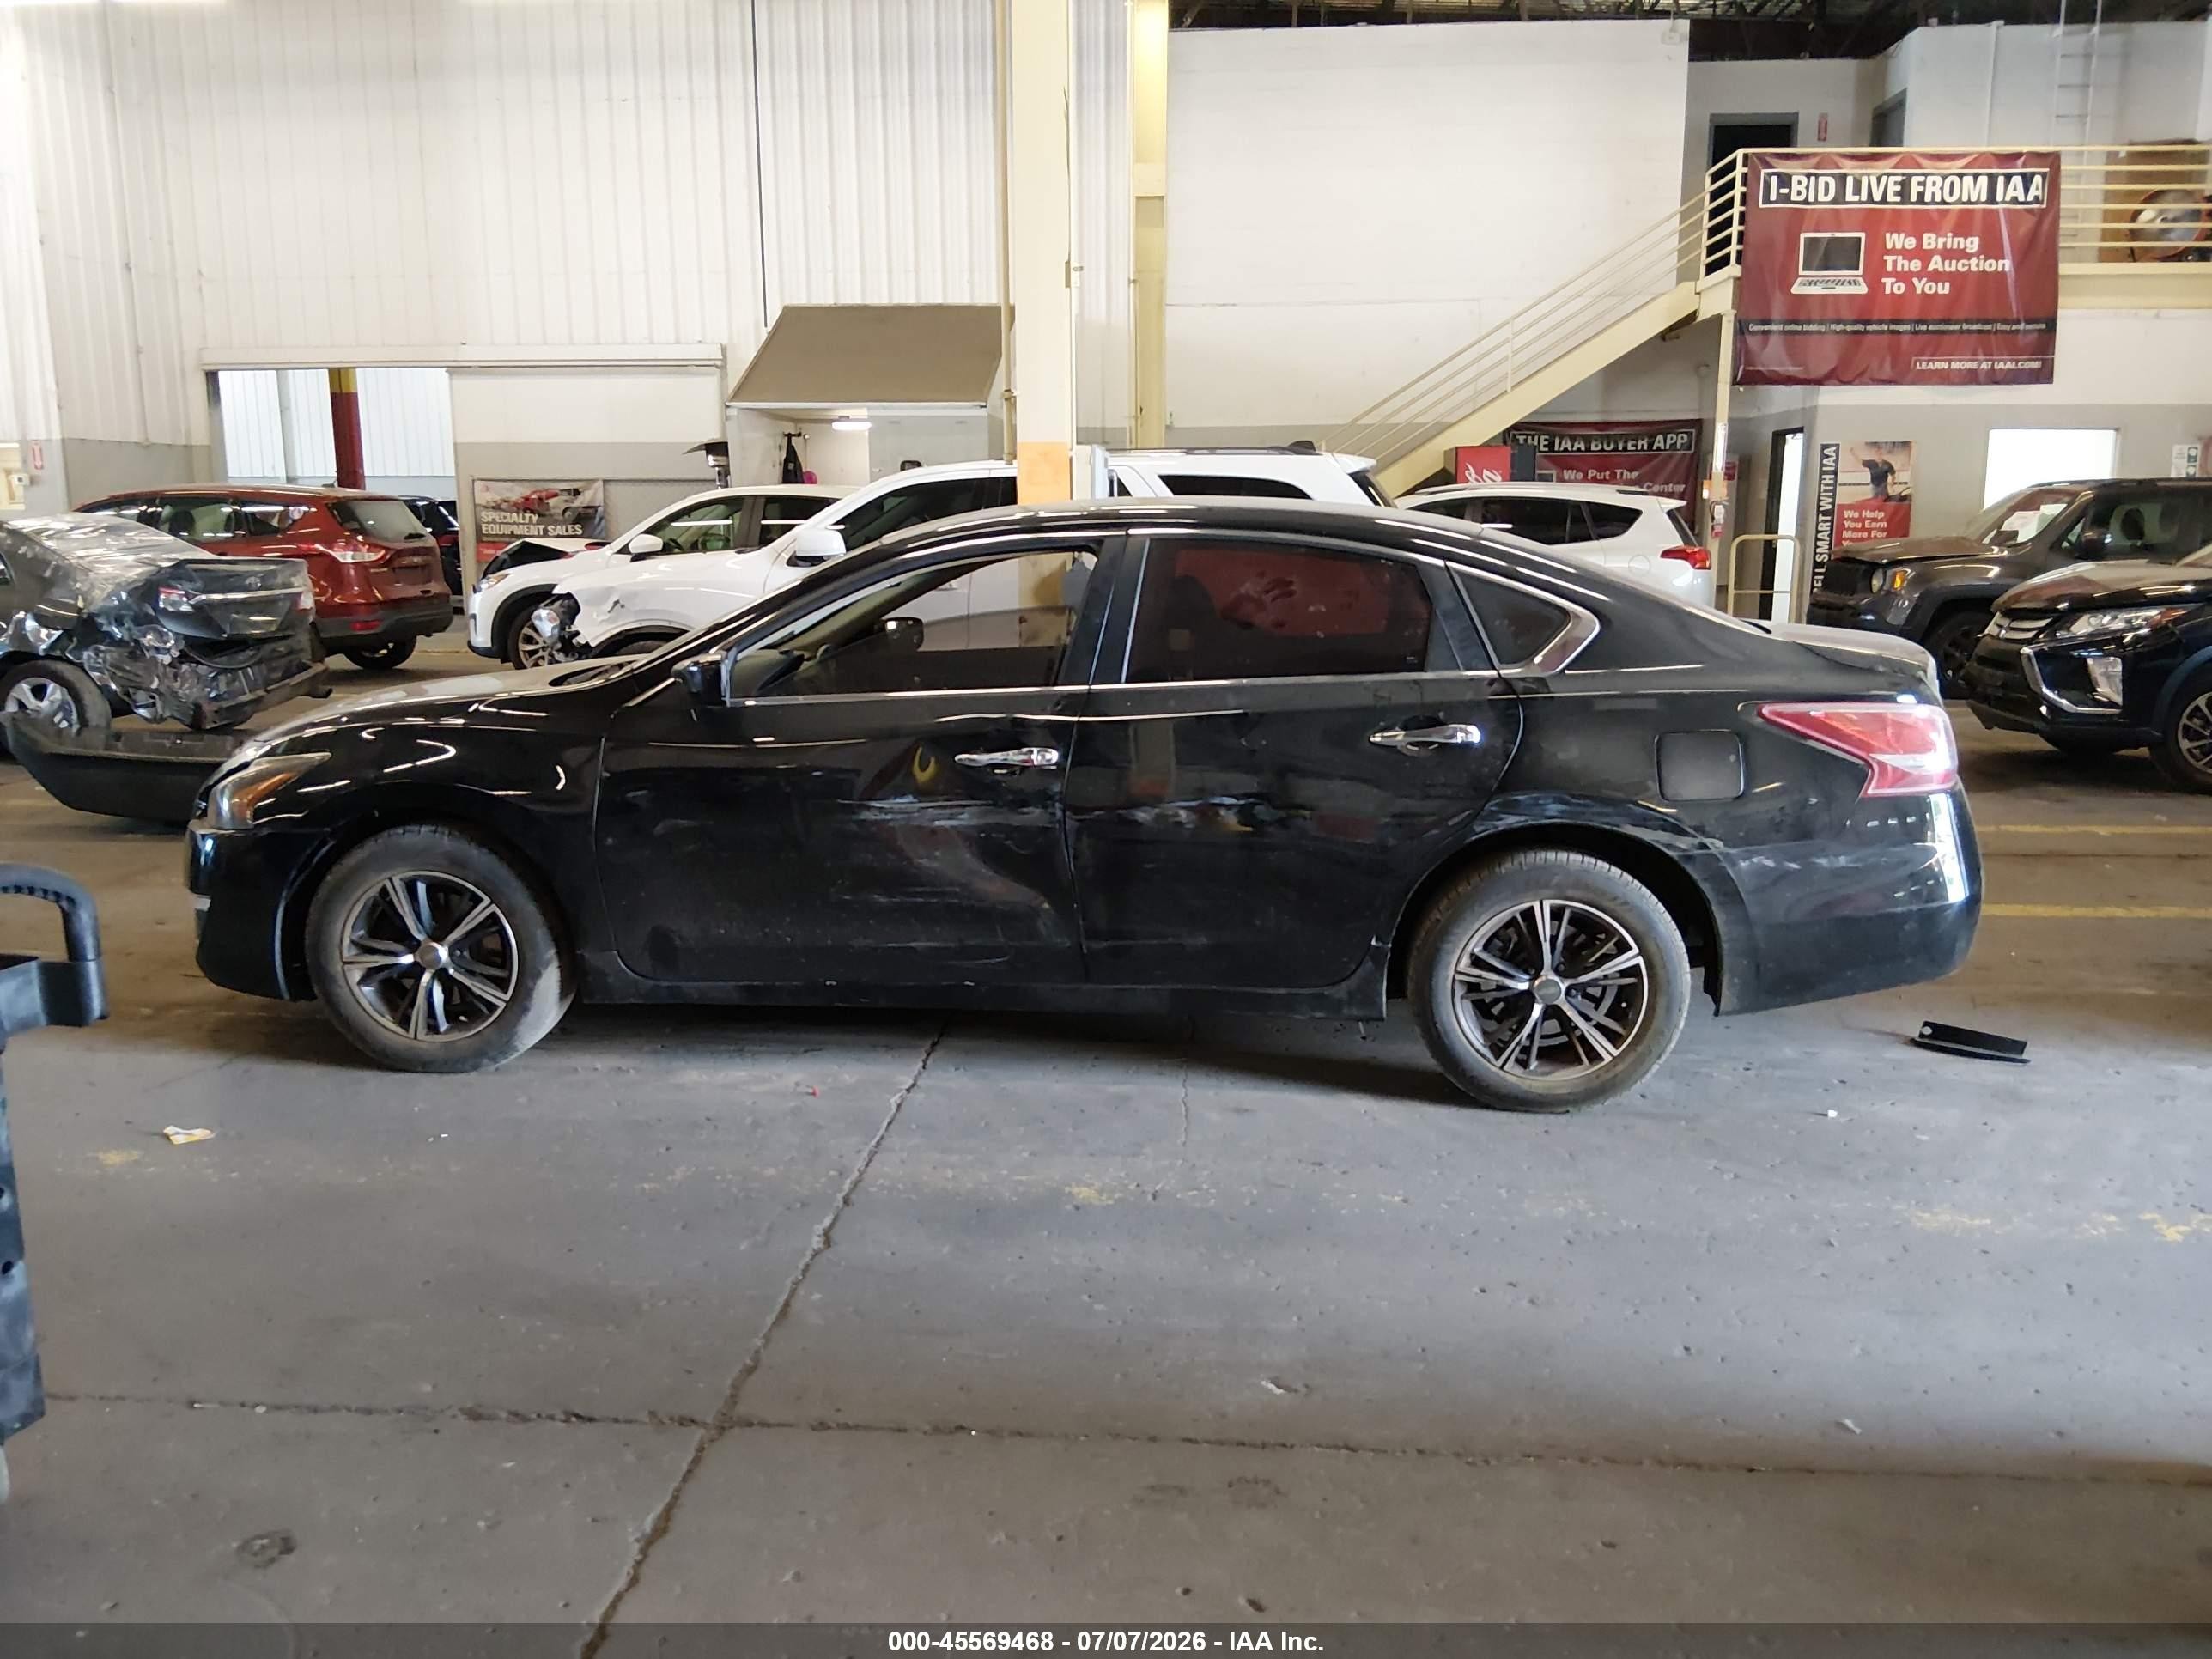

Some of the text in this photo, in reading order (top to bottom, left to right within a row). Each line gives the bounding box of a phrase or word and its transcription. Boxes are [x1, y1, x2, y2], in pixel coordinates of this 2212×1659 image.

[1770, 174, 2044, 202] I-BID LIVE FROM IAA
[1885, 233, 1979, 253] We Bring
[1883, 255, 2010, 272] The Auction
[1881, 277, 1950, 295] To You
[1916, 361, 1948, 370] LEARN
[1950, 361, 1978, 369] MORE
[1980, 361, 1993, 369] AT
[1553, 435, 1585, 452] IAA
[1590, 435, 1649, 452] BUYER
[1652, 433, 1688, 451] APP
[1822, 446, 1837, 471] IAA
[1563, 469, 1583, 481] We
[1588, 469, 1610, 481] Put
[1643, 482, 1686, 493] Center
[1820, 475, 1835, 512] WITH
[481, 511, 538, 524] SPECIALTY
[1844, 509, 1885, 520] We Help
[481, 523, 583, 536] EQUIPMENT SALES
[1844, 520, 1887, 528] You Earn
[1815, 514, 1832, 562] SMART
[1842, 530, 1887, 538] More For
